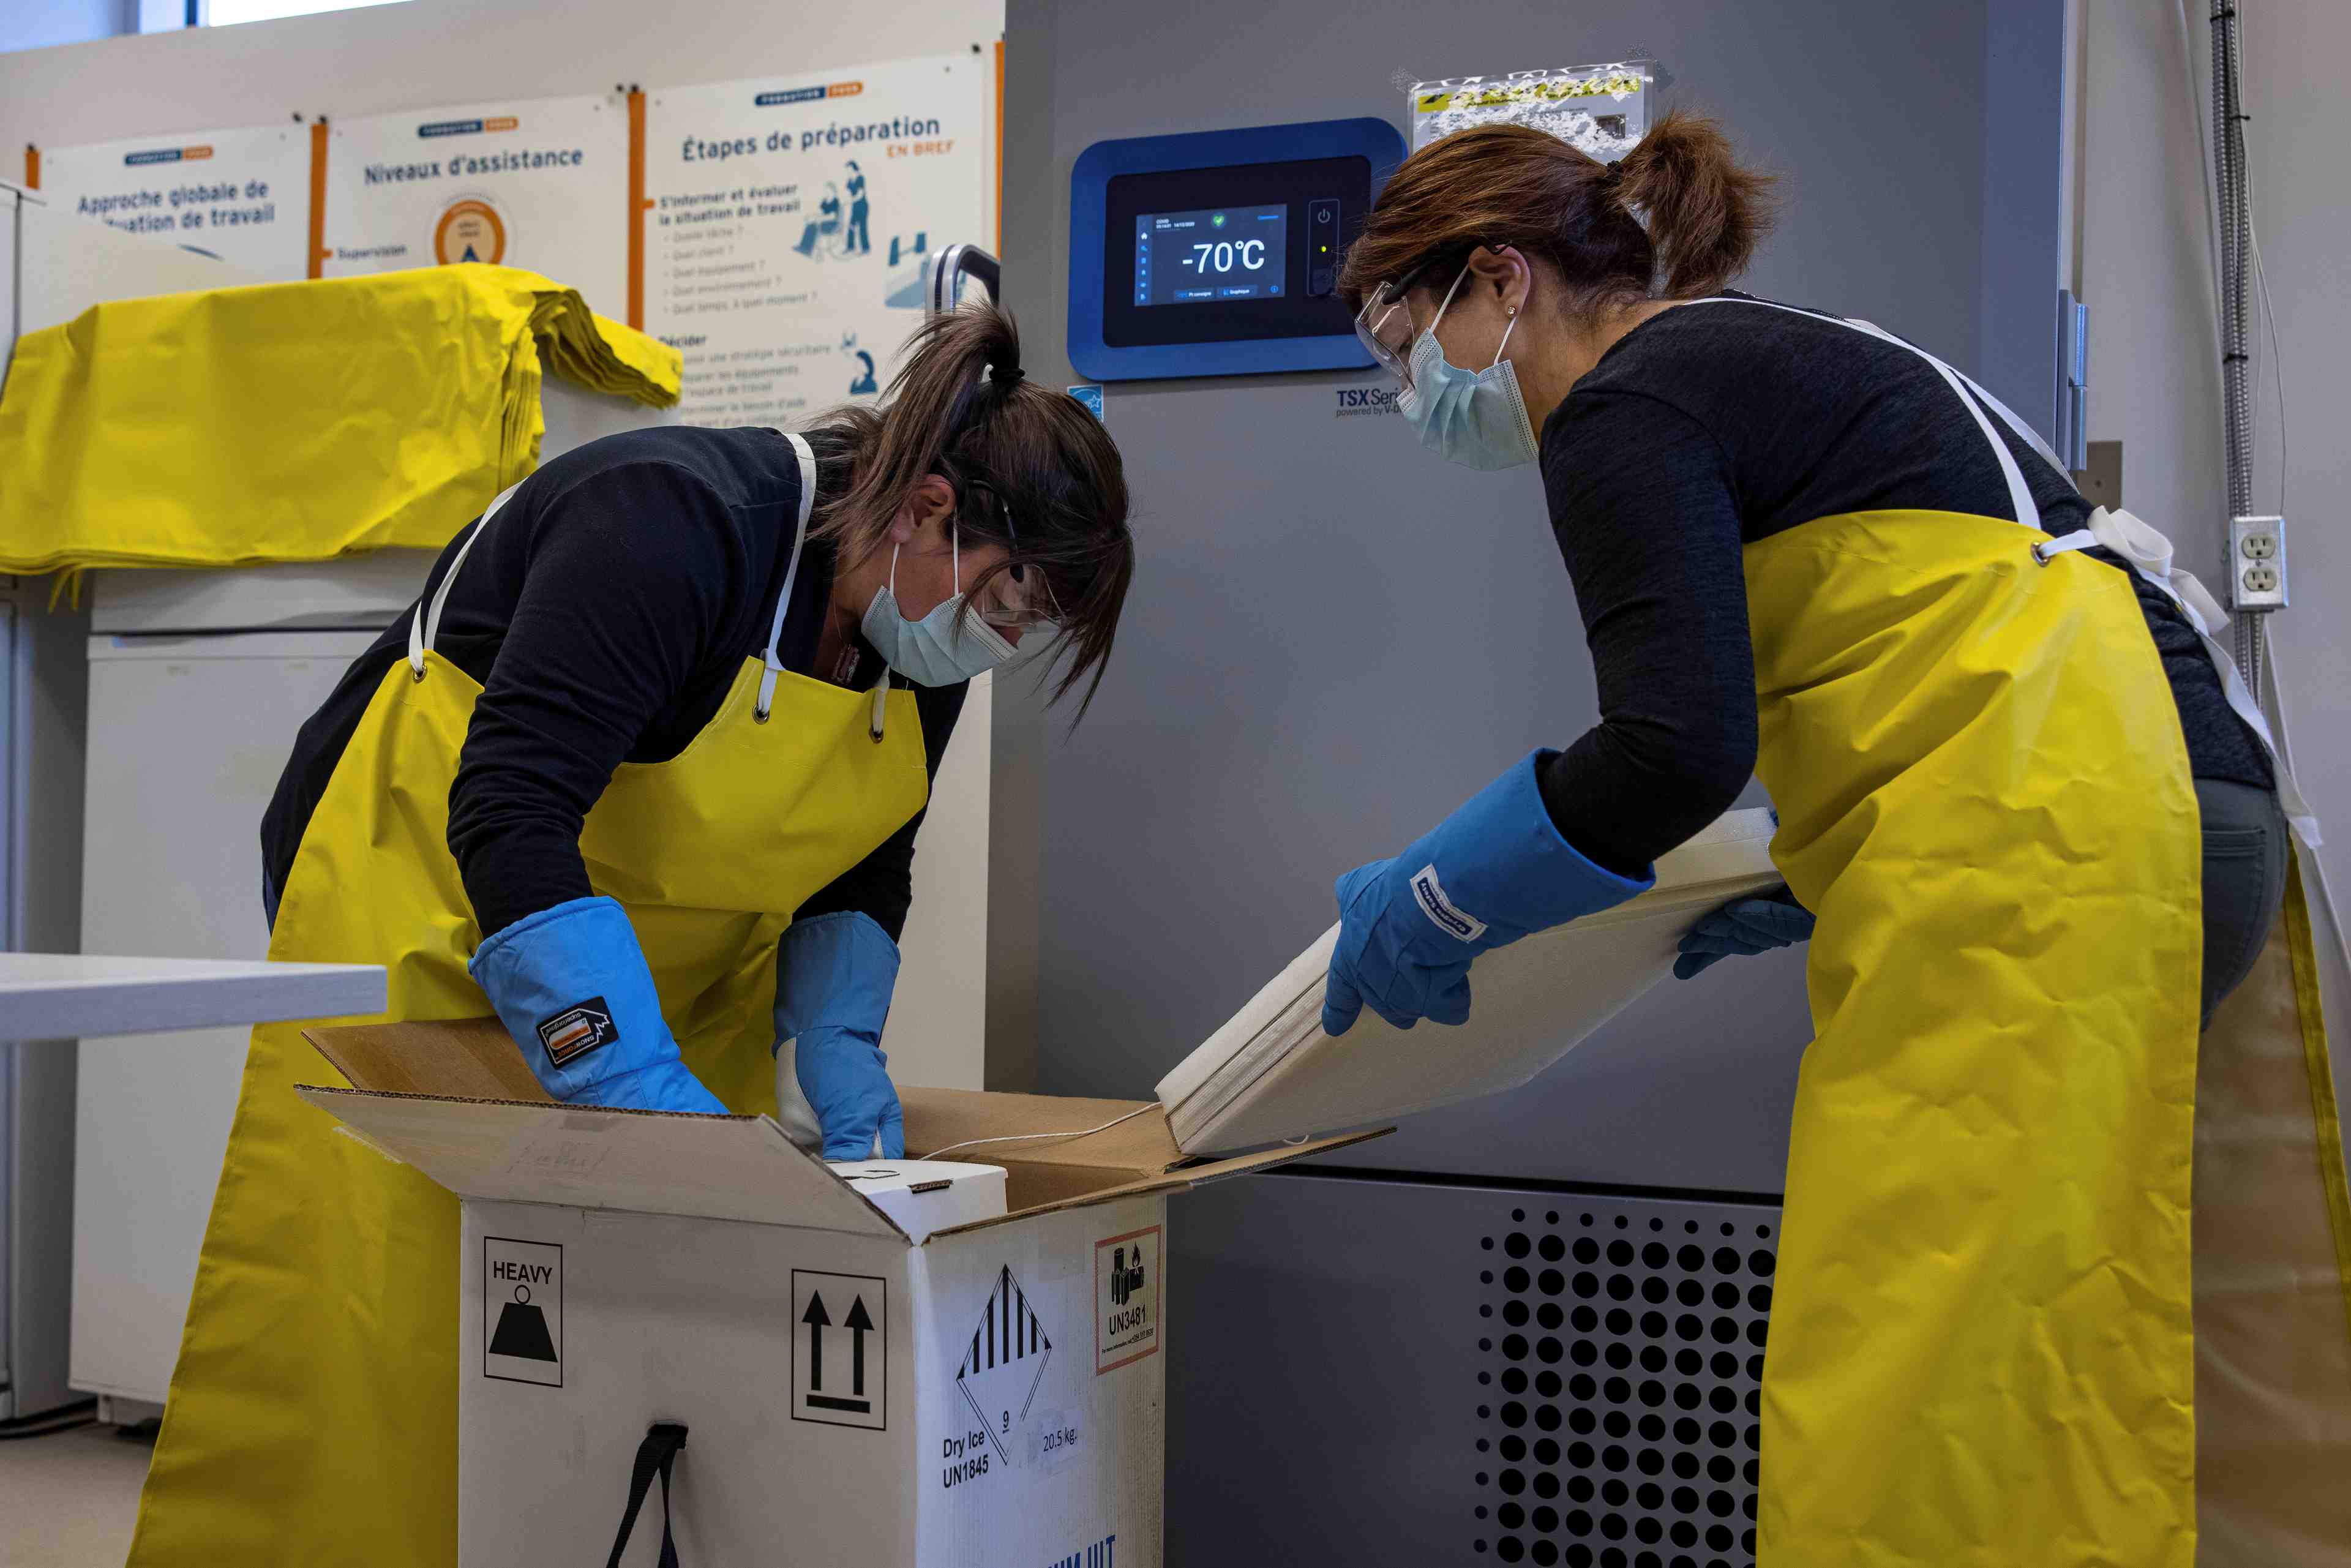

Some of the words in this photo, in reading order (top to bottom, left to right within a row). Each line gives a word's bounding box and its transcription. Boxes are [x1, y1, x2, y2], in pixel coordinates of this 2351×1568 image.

[682, 134, 757, 162] Étapes
[766, 129, 793, 152] de
[801, 116, 940, 151] préparation
[887, 144, 908, 159] EN
[913, 140, 954, 157] BREF
[364, 162, 440, 185] Niveaux
[449, 148, 583, 177] d'assistance
[77, 189, 163, 216] Approche
[168, 182, 238, 209] globale
[245, 179, 268, 200] de
[181, 209, 203, 230] de
[210, 201, 276, 227] travail
[337, 244, 407, 260] Supervision
[1182, 239, 1265, 274] -70°C
[1337, 389, 1370, 407] TSX
[1371, 387, 1402, 405] Seri
[1336, 407, 1371, 418] powered
[1374, 406, 1383, 416] by
[493, 1261, 553, 1285] HEAVY
[1109, 1304, 1146, 1336] UN3481
[1003, 1410, 1010, 1428] 9
[943, 1437, 966, 1459] Dry
[968, 1430, 985, 1449] Ice
[1043, 1430, 1063, 1453] 20.5
[1065, 1427, 1078, 1446] kg.
[943, 1453, 989, 1488] UN1845
